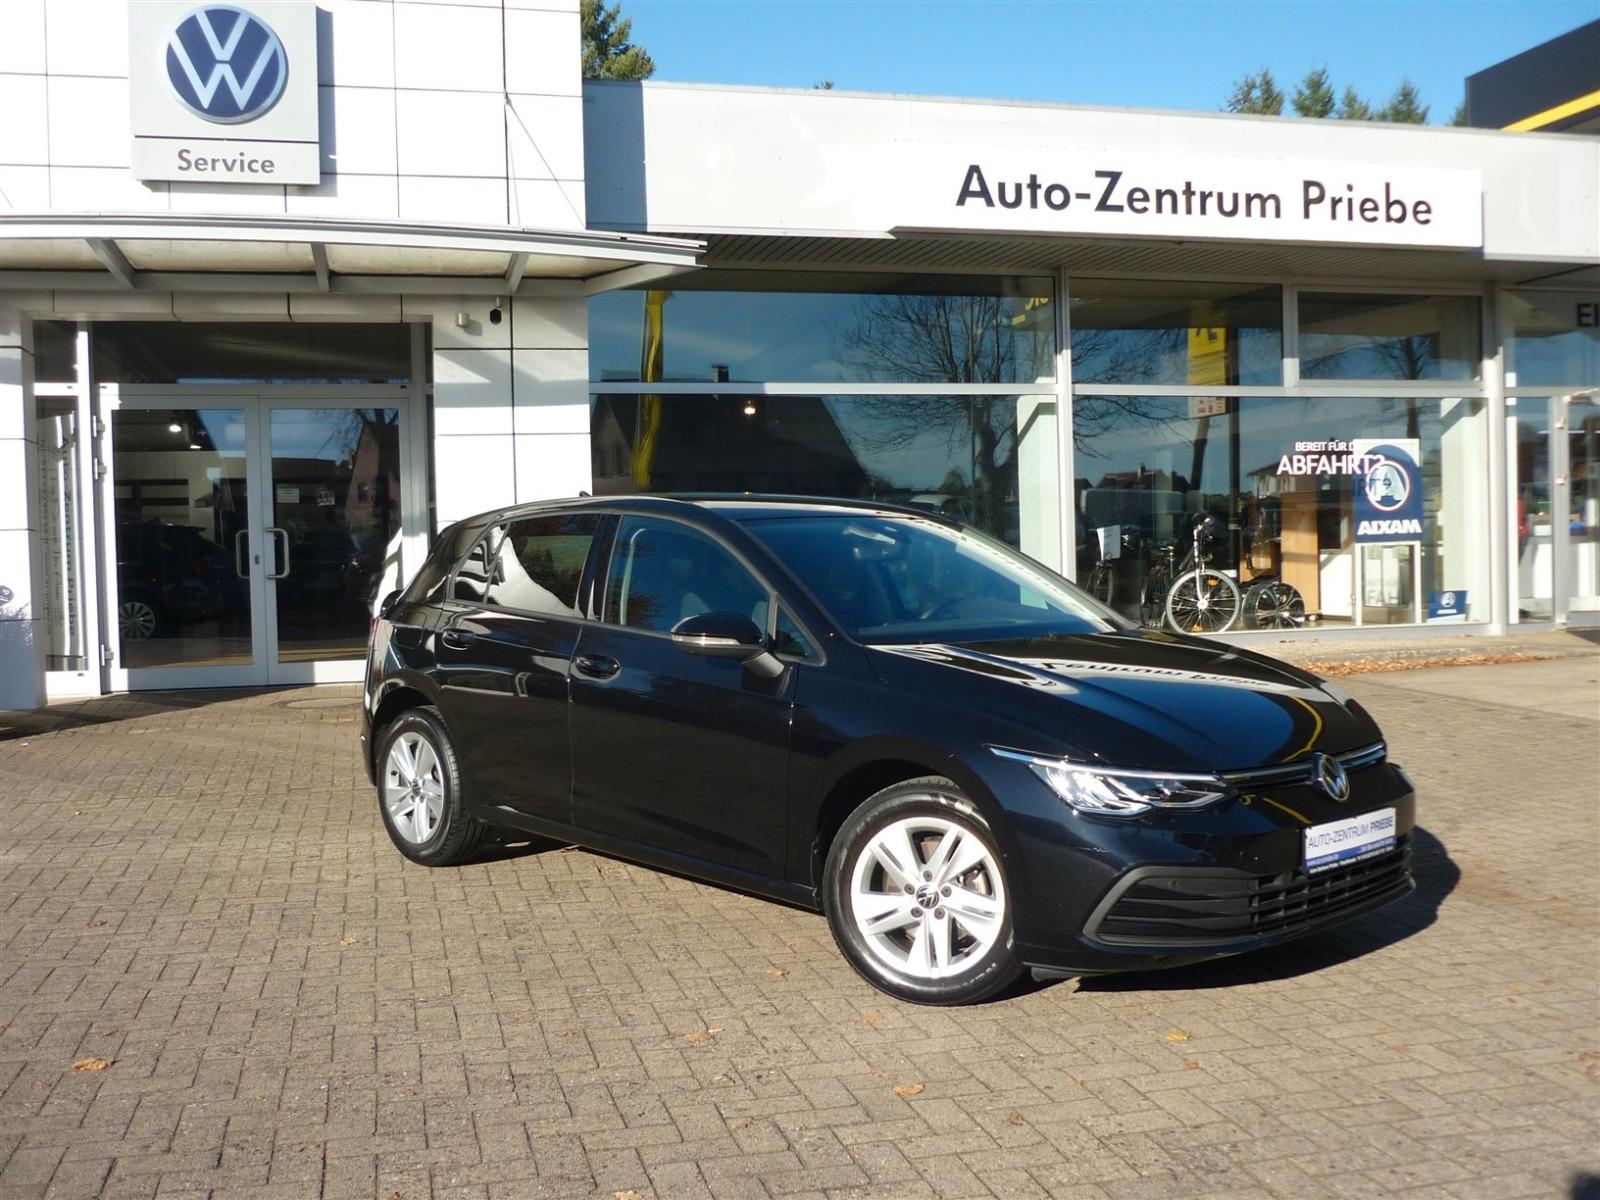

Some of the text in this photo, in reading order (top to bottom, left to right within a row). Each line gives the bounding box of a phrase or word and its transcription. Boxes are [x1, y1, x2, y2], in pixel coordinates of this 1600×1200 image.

[177, 148, 276, 174] Service
[955, 164, 1434, 225] Auto-Zentrum Priebe
[1295, 441, 1326, 452] BEREIT
[1328, 439, 1347, 451] FÜR
[1357, 518, 1423, 535] AIXAM
[1308, 823, 1369, 848] AUTO-ZENTRUM
